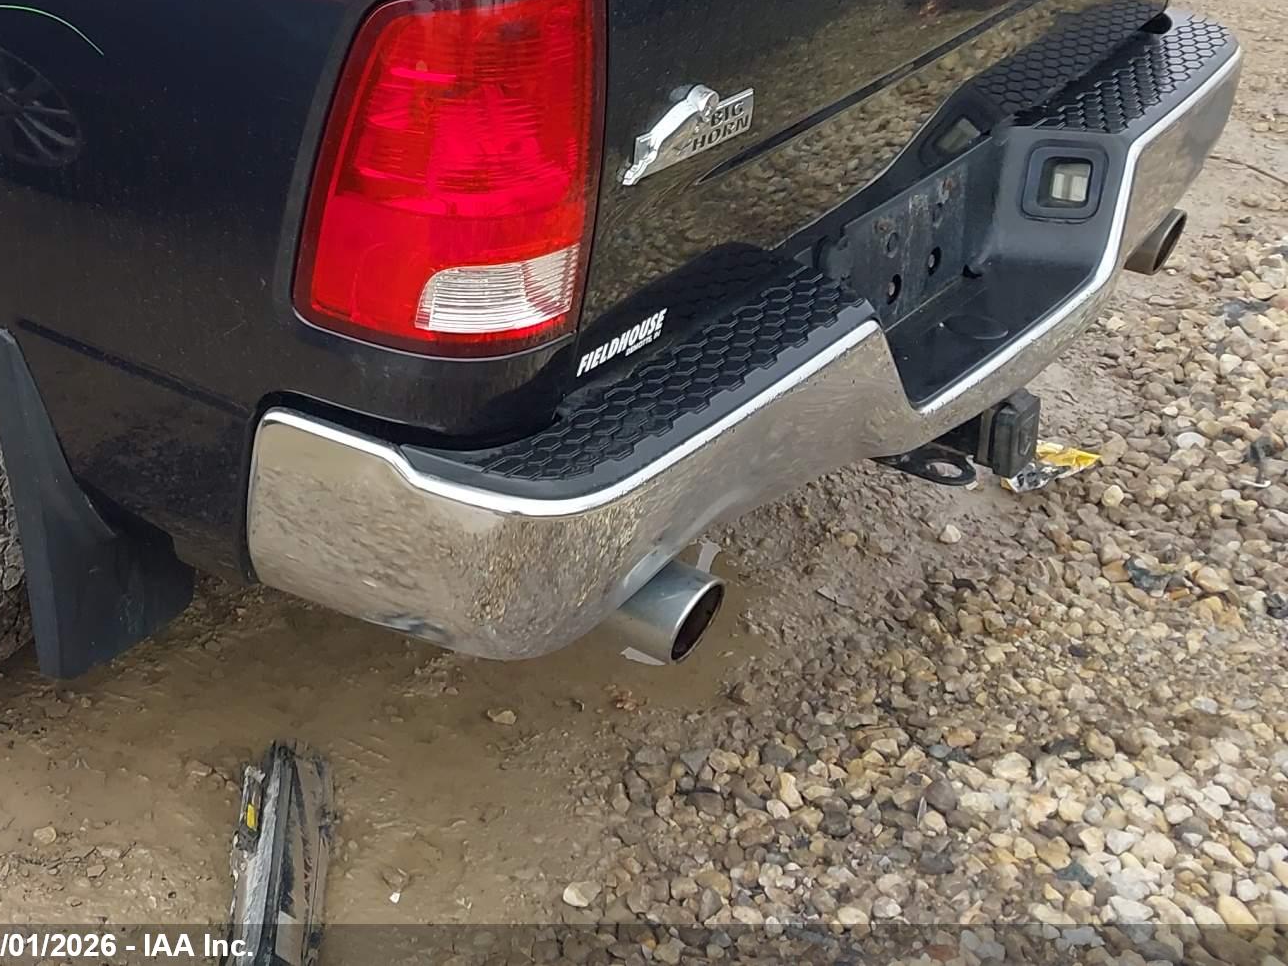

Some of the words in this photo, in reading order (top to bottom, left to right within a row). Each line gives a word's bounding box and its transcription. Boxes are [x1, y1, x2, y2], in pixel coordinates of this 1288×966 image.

[711, 100, 745, 127] BIG
[692, 114, 749, 152] HORN
[576, 307, 668, 378] FIELDHOUSE
